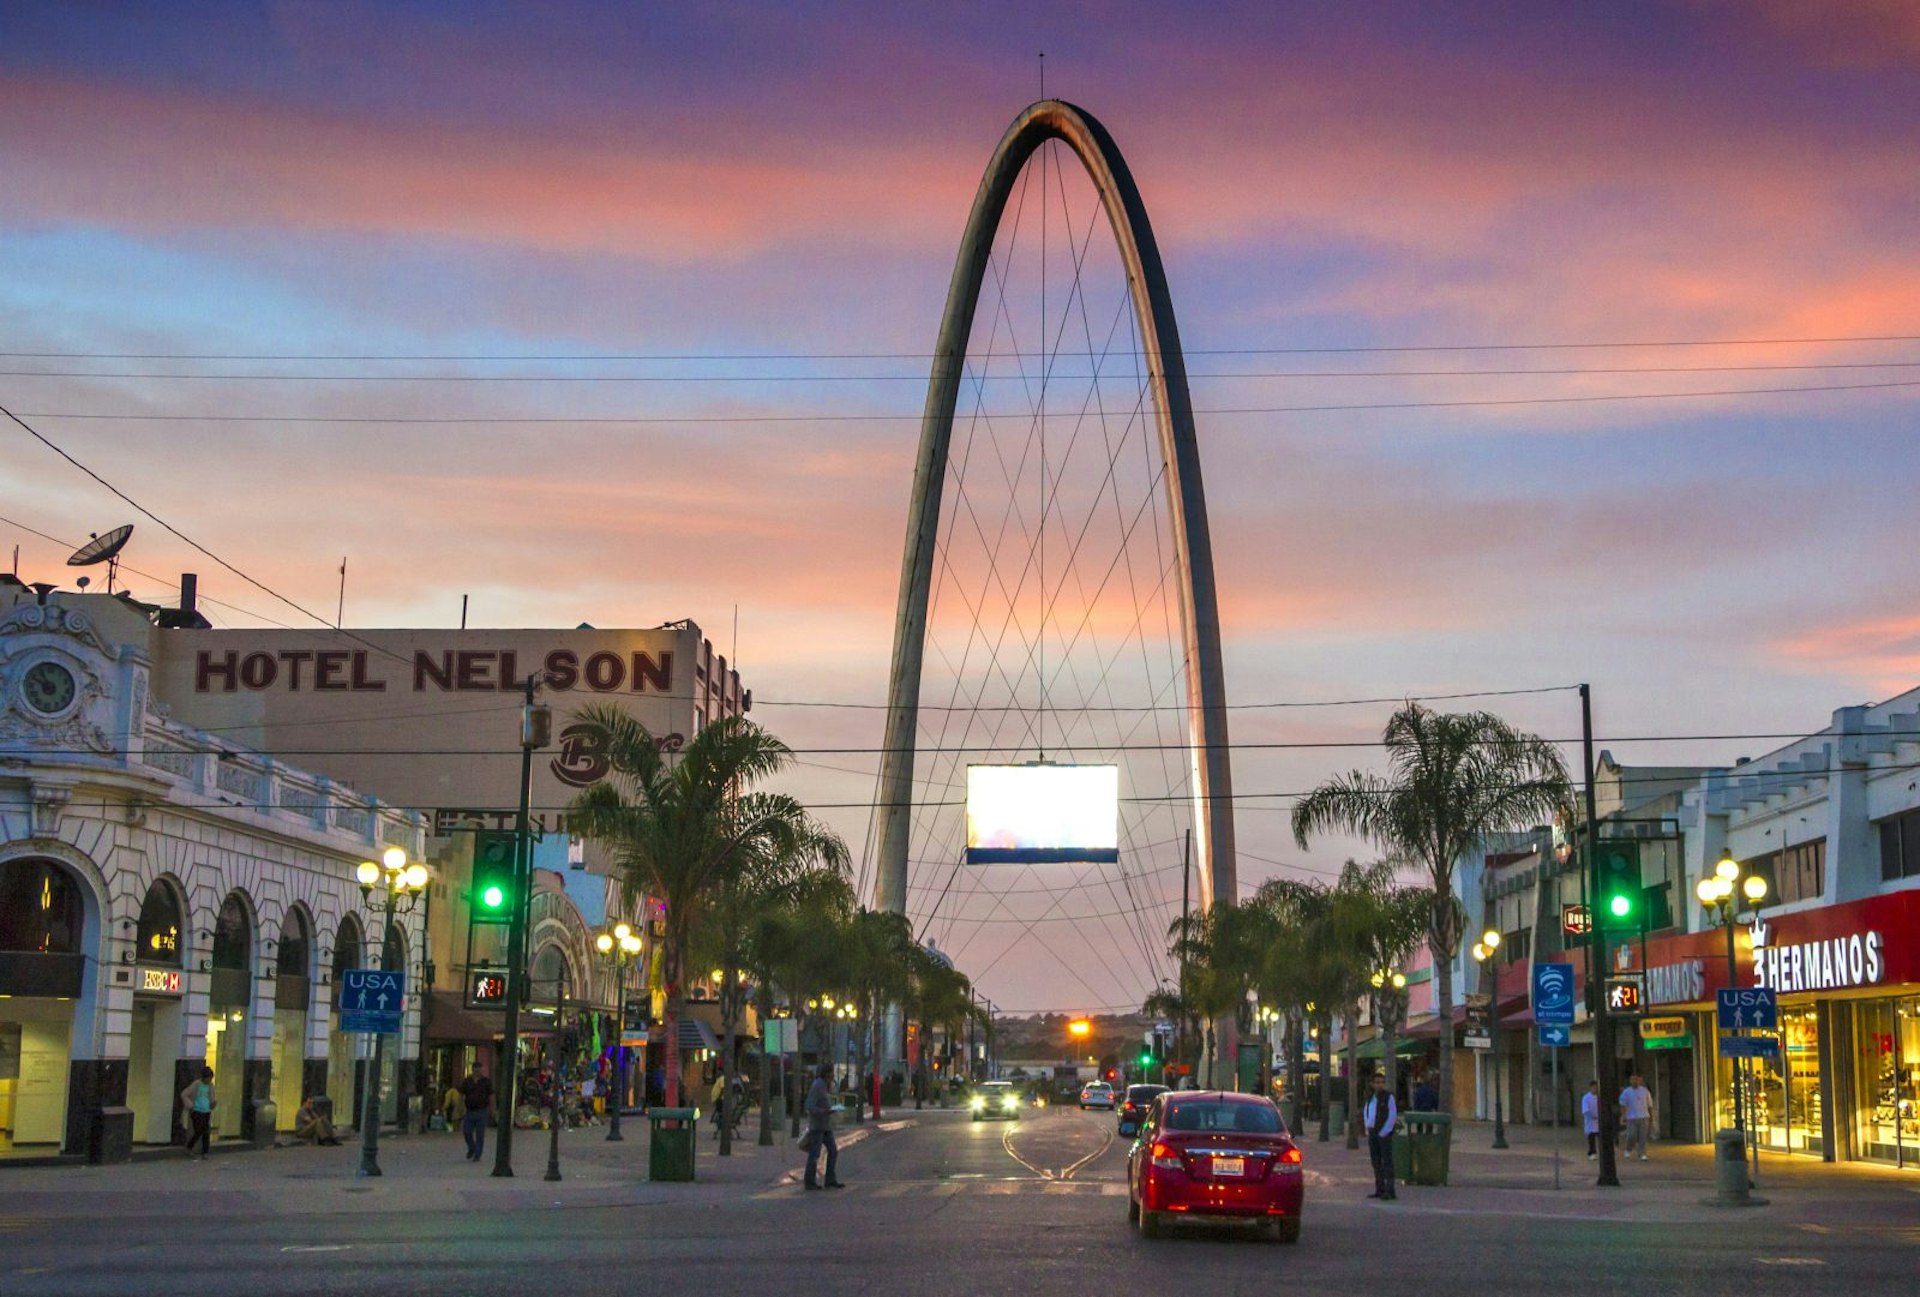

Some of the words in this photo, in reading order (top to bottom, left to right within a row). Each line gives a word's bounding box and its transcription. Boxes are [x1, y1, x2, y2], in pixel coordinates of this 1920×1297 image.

[195, 650, 387, 692] HOTEL
[413, 650, 674, 693] NELSON
[1767, 930, 1879, 993] HERMANOS
[144, 970, 167, 991] HSBC
[349, 973, 398, 990] USA
[1637, 959, 1705, 1005] ERMANOS
[1623, 986, 1638, 1006] 21
[1723, 991, 1771, 1007] USA
